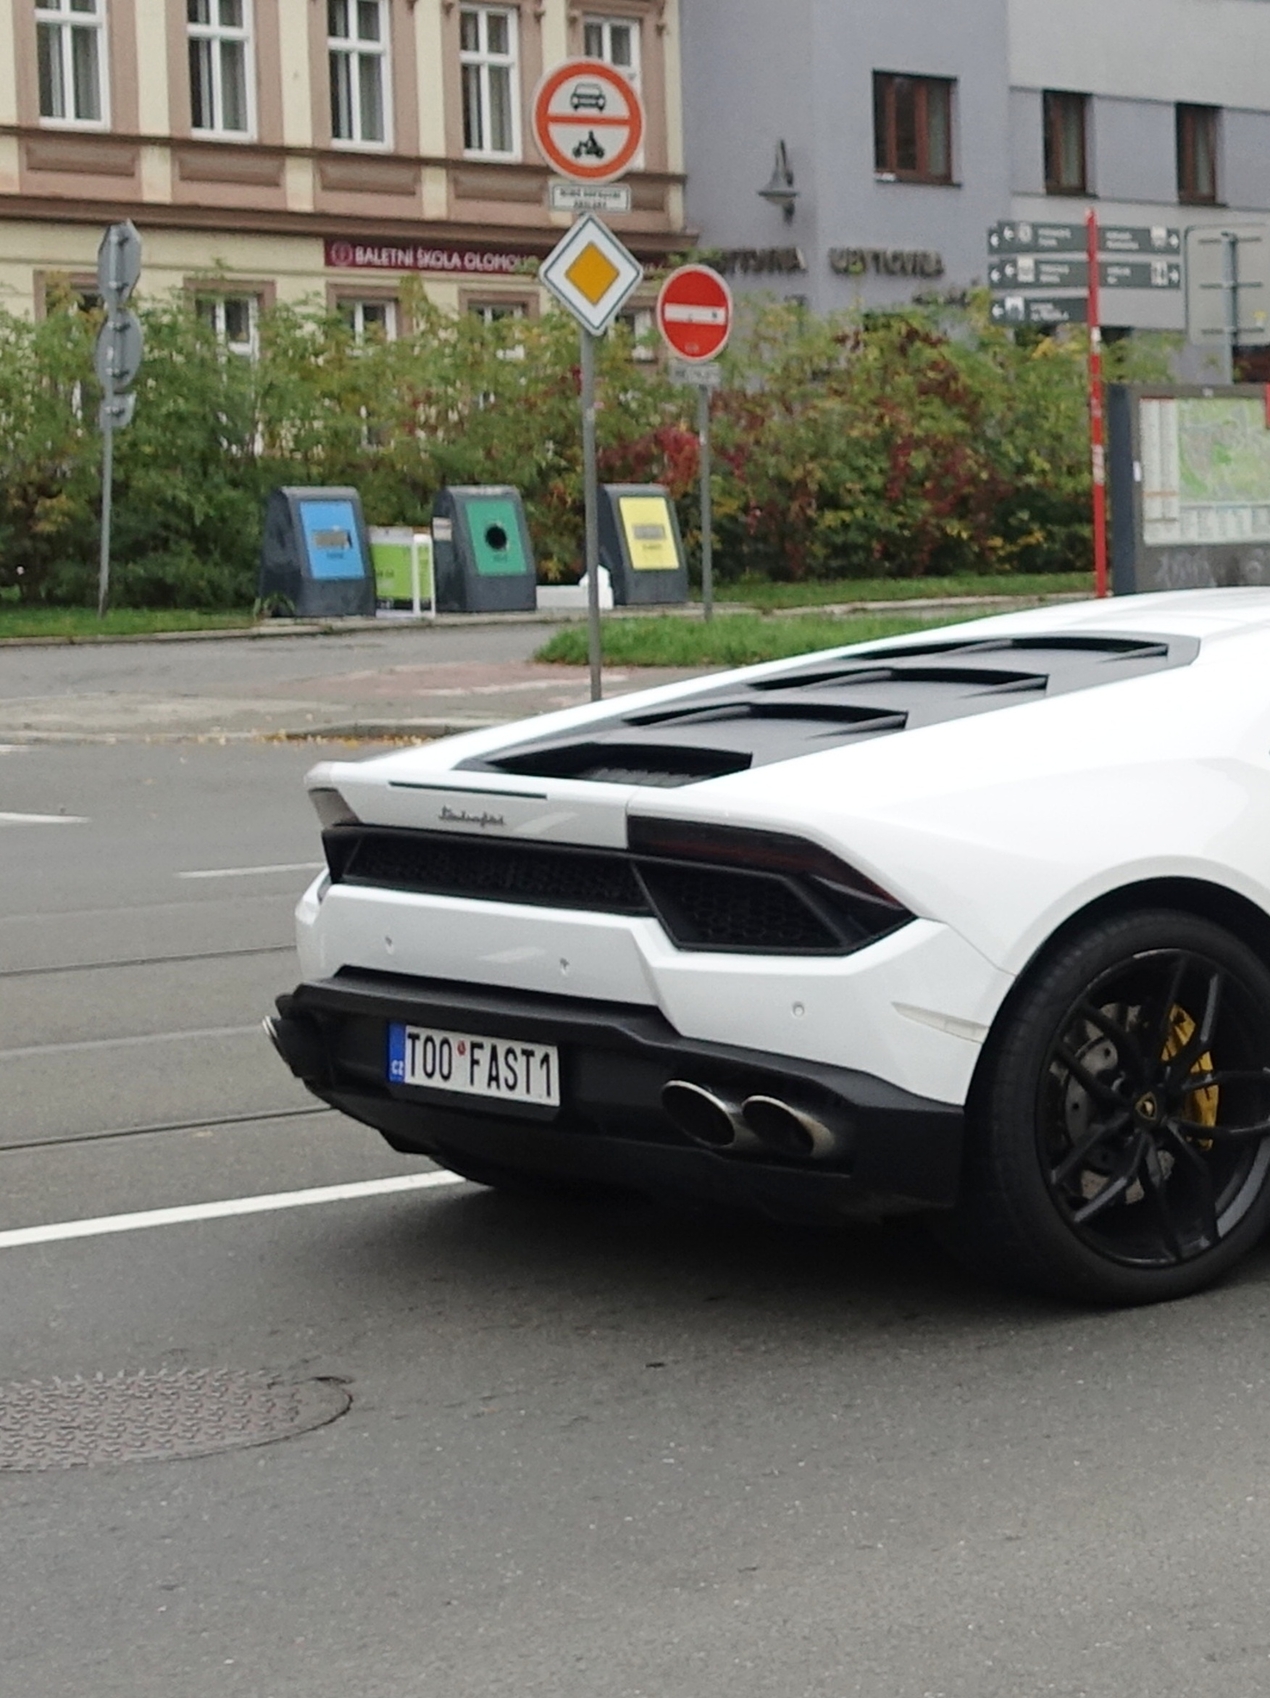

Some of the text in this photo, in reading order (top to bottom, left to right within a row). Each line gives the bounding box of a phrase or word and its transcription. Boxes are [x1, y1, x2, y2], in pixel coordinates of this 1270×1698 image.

[354, 245, 414, 267] BALETNÍ
[416, 246, 462, 270] ŠKOLA
[391, 1059, 405, 1076] CZ
[470, 1041, 552, 1098] FAST1
